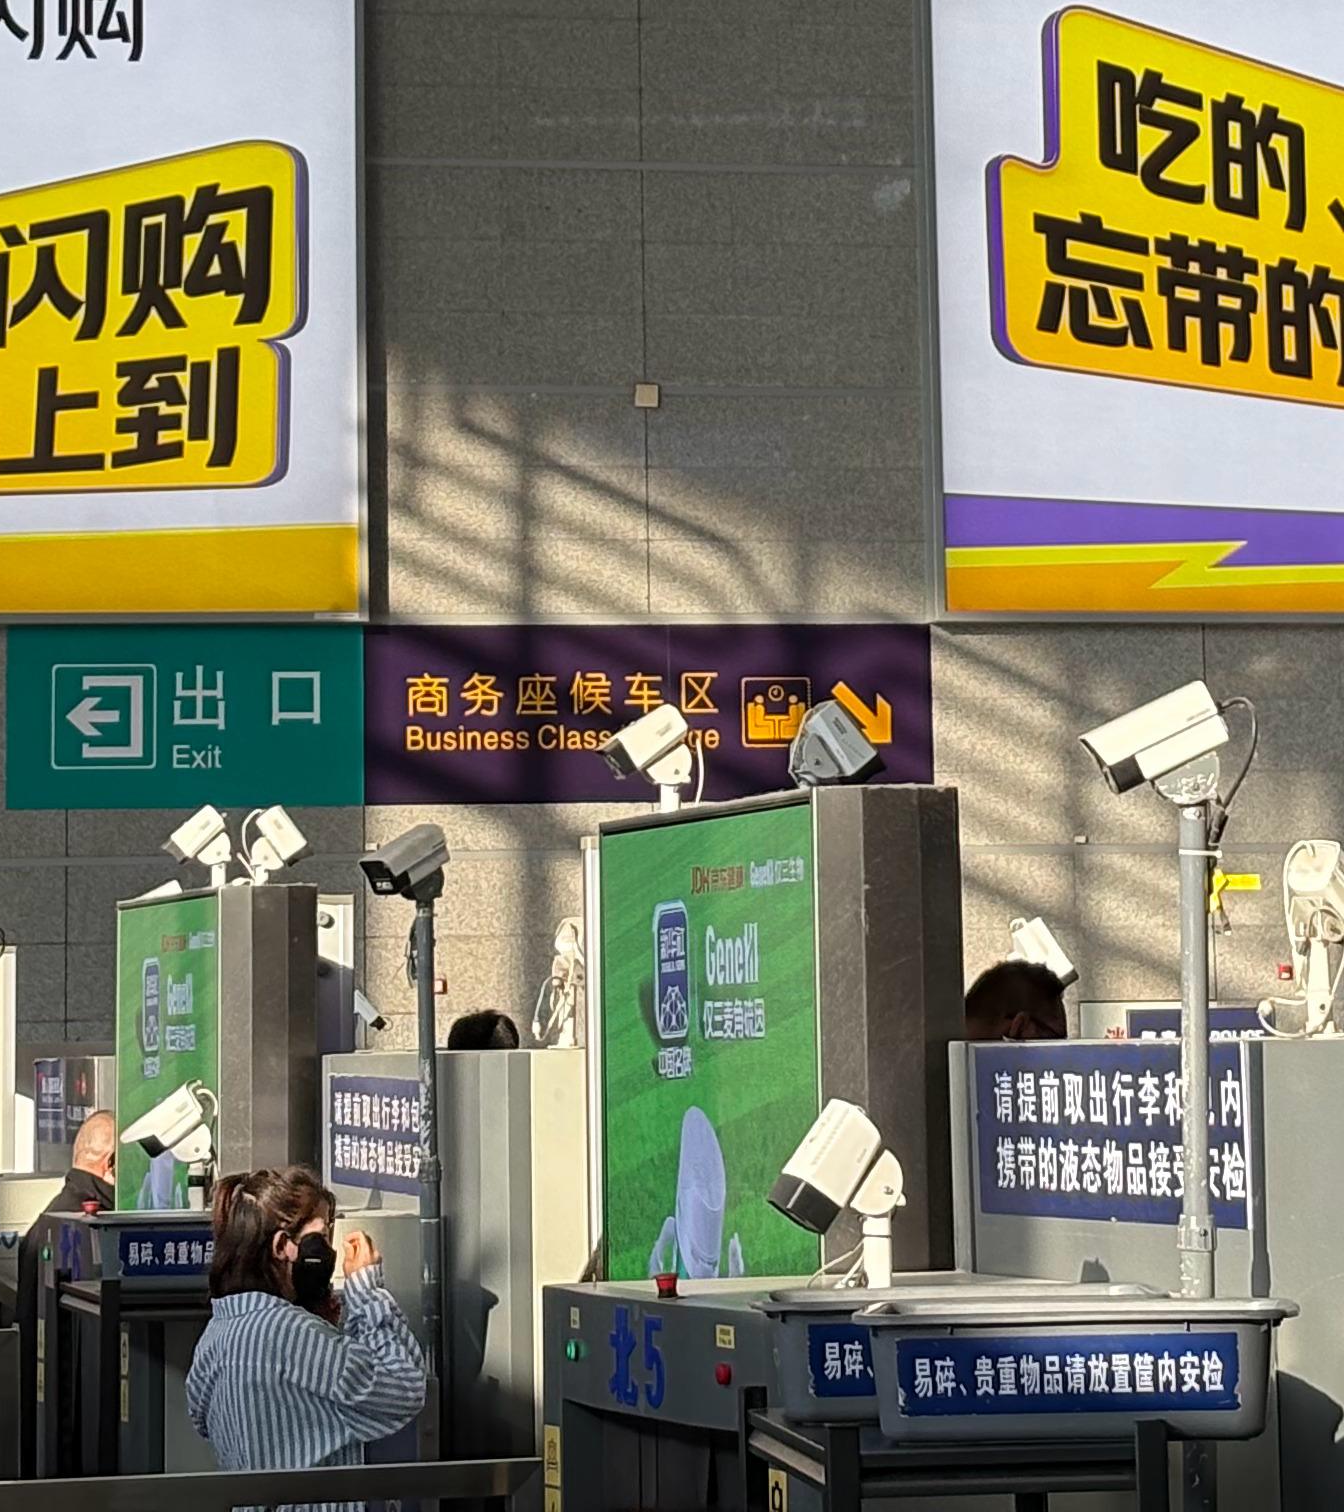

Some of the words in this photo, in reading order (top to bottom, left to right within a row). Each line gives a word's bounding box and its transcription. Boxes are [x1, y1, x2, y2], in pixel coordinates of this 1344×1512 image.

[173, 664, 323, 733] 出口
[406, 671, 720, 719] 商务座候车区
[172, 745, 223, 771] Exit
[406, 725, 529, 751] Business
[538, 725, 611, 751] Class
[994, 1069, 1242, 1128] 请提前取出行李和内
[914, 1349, 1225, 1399] 易碎、贵重物品请放置筐内安检
